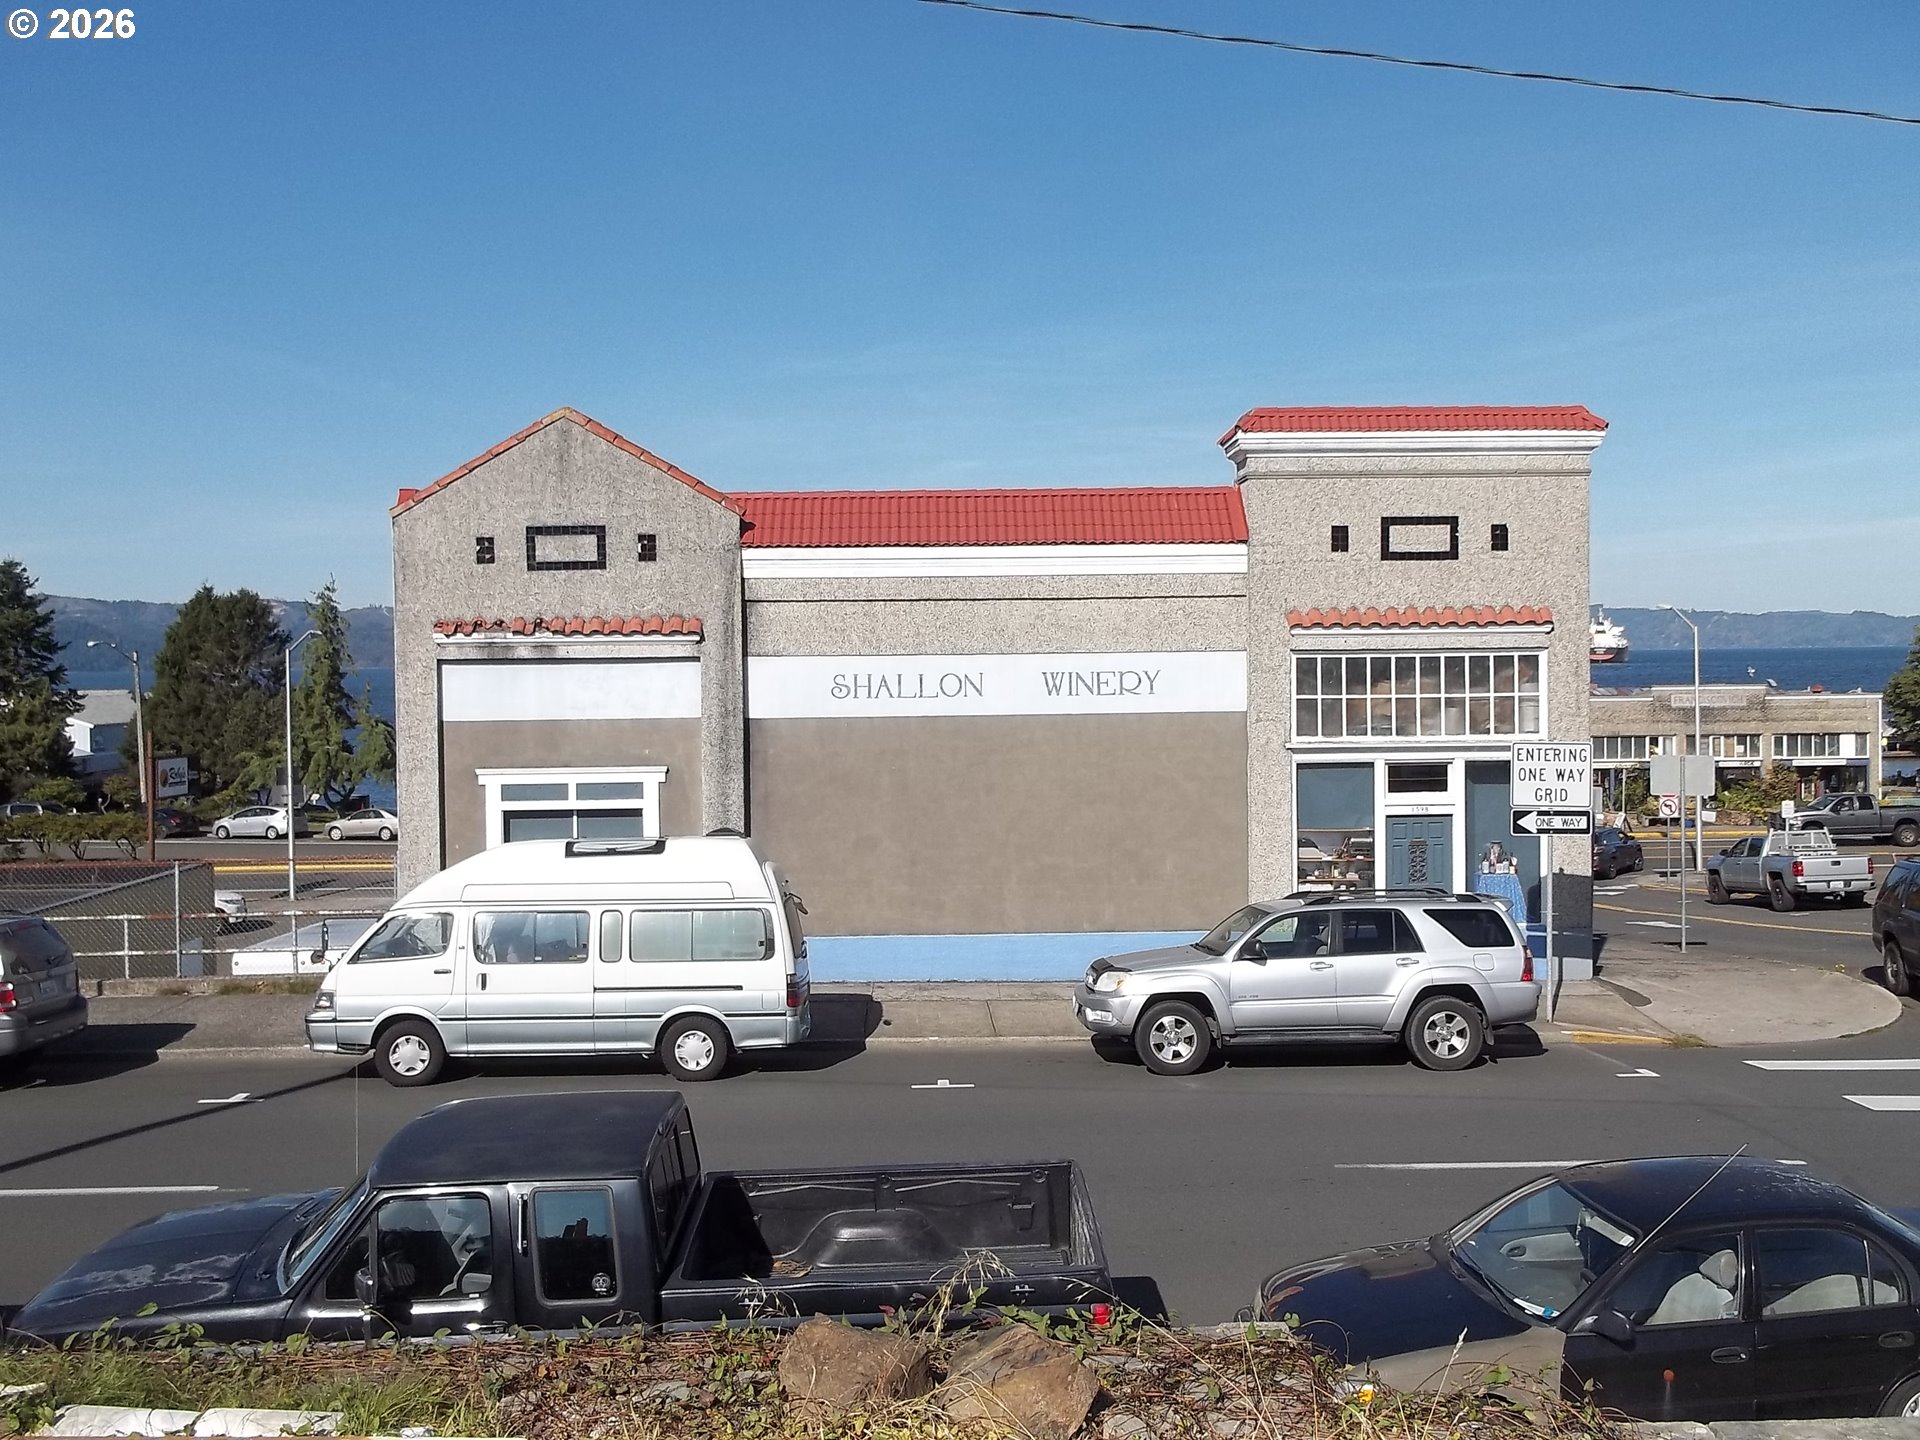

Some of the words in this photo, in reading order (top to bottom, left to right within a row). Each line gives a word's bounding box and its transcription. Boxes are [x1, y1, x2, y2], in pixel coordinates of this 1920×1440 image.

[830, 671, 984, 700] SHALLON
[1041, 669, 1161, 697] WINERY
[1516, 747, 1588, 763] ENTERING
[1518, 767, 1547, 782] ONE
[1555, 768, 1586, 783] WAY
[1534, 787, 1569, 803] GRID
[1535, 817, 1556, 828] ONE
[1560, 817, 1583, 828] WAY
